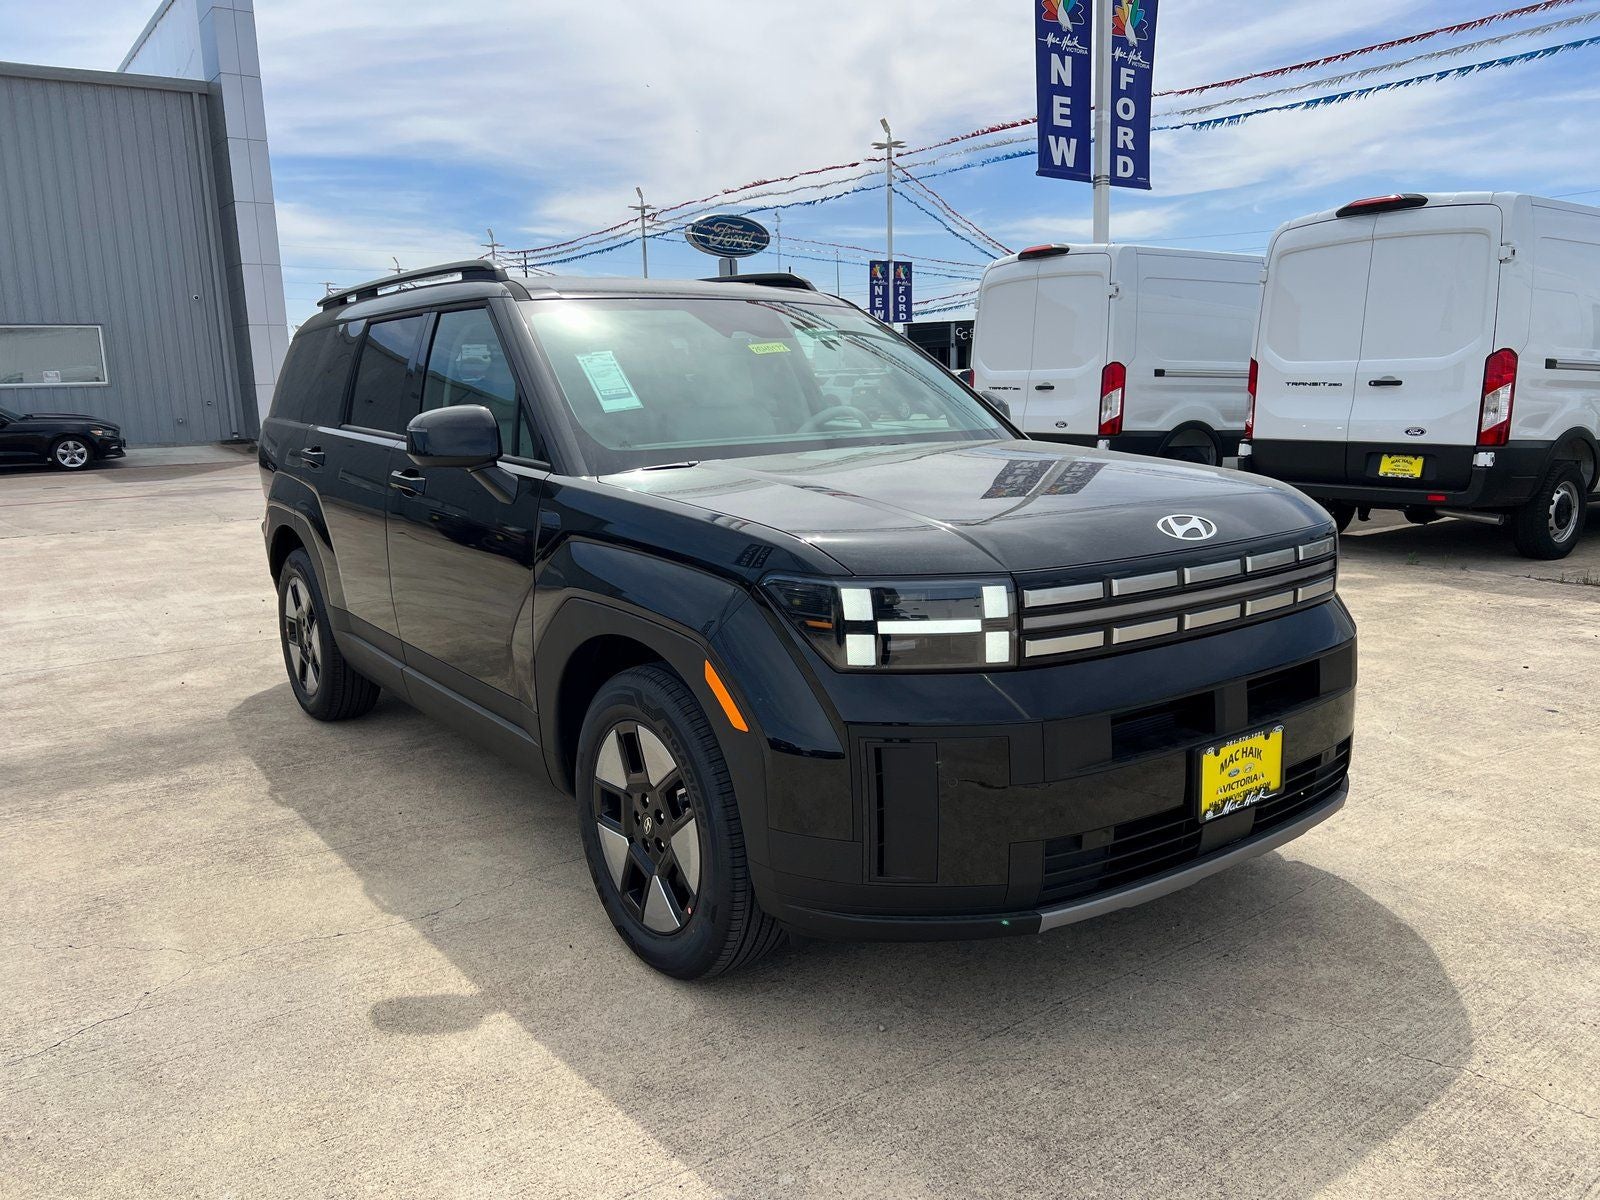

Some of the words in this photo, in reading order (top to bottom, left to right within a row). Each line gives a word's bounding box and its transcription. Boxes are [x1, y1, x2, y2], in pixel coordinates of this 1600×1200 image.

[1048, 53, 1077, 168] NEW
[1116, 67, 1135, 178] FORD
[709, 222, 755, 248] Ford
[874, 286, 885, 320] NEW
[898, 286, 907, 320] FORD
[1220, 749, 1240, 774] MAC
[1241, 746, 1263, 761] HAIK
[1222, 774, 1258, 793] VICTORIA
